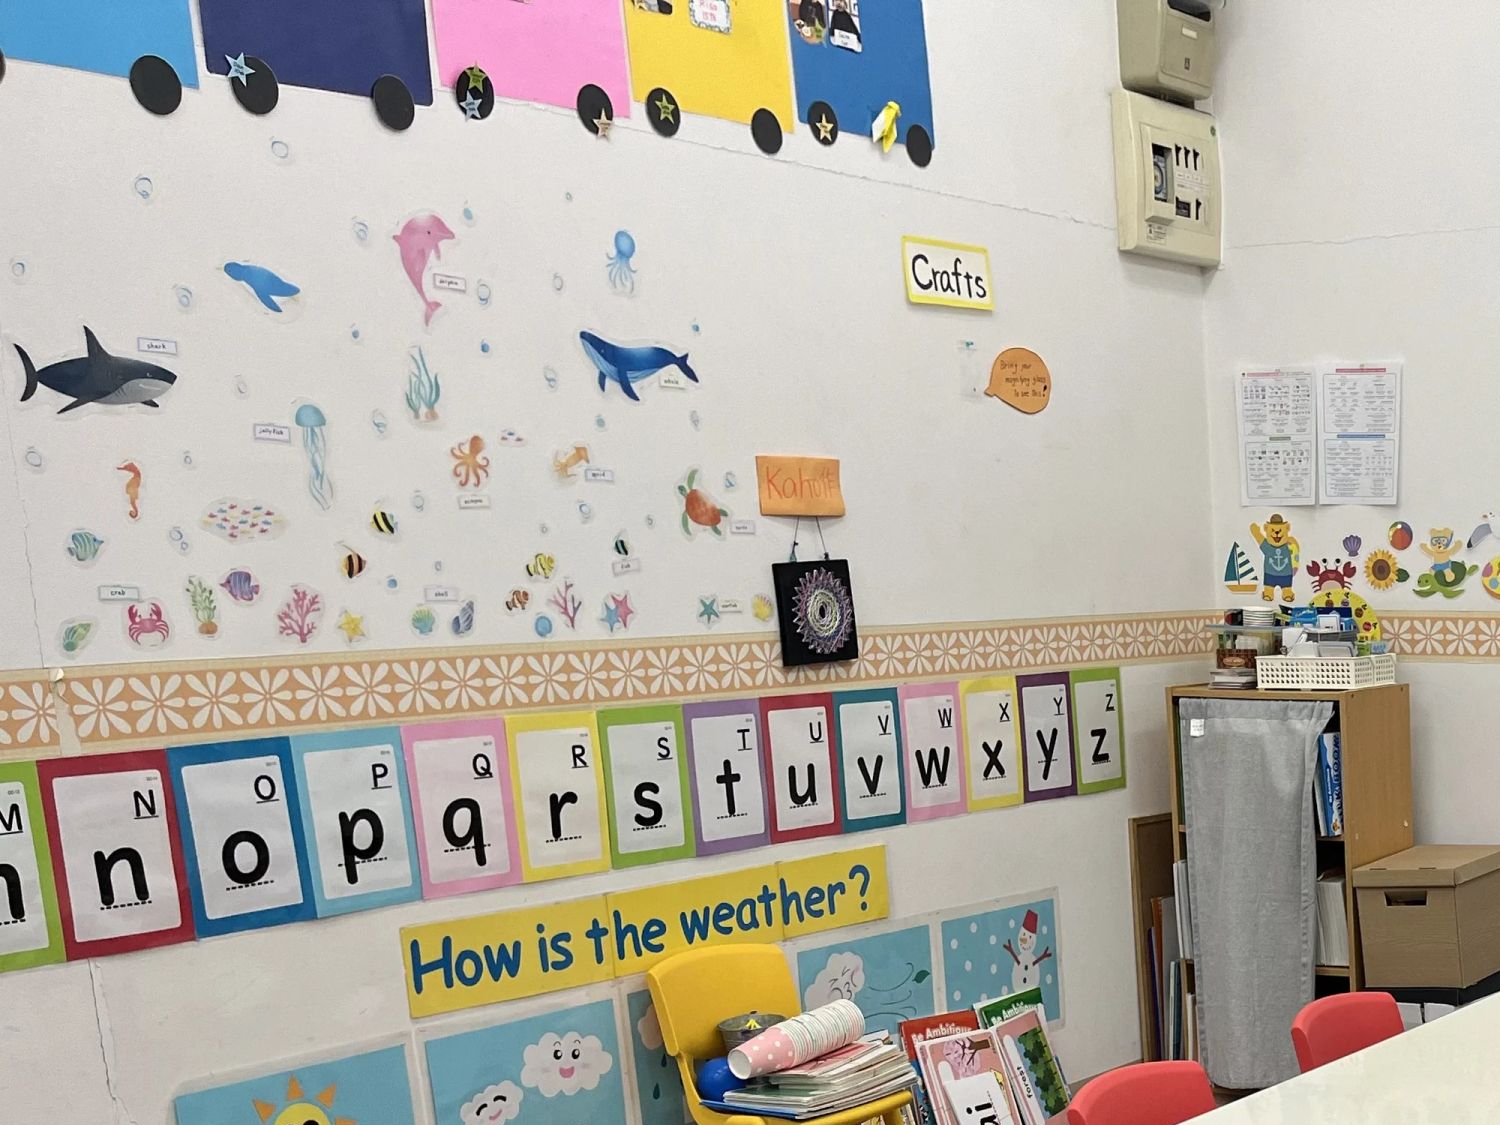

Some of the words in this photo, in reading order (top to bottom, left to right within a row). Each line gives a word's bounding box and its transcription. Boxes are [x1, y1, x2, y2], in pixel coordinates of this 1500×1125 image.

[912, 253, 986, 299] Crafts
[938, 708, 952, 727] W
[1000, 702, 1009, 720] X
[1053, 696, 1063, 714] Y
[1105, 694, 1115, 711] Z
[737, 729, 752, 749] T
[809, 721, 823, 742] U
[878, 714, 889, 734] V
[572, 744, 588, 767] R
[656, 736, 671, 758] S
[982, 740, 1005, 778] x
[1036, 728, 1058, 780] y
[1090, 729, 1109, 762] z
[371, 764, 389, 787] P
[473, 753, 493, 777] Q
[857, 755, 883, 795] v
[915, 746, 950, 787] w
[254, 775, 276, 799] O
[716, 759, 740, 815] t
[788, 763, 817, 805] u
[134, 790, 157, 816] N
[548, 790, 578, 840] r
[633, 781, 663, 827] s
[338, 807, 384, 884] p
[442, 797, 487, 866] q
[222, 831, 270, 883] o
[94, 846, 150, 906] n
[410, 935, 521, 995] How
[536, 923, 573, 974] is
[585, 910, 666, 964] the
[680, 864, 871, 945] weather?
[1016, 1066, 1033, 1099] forest
